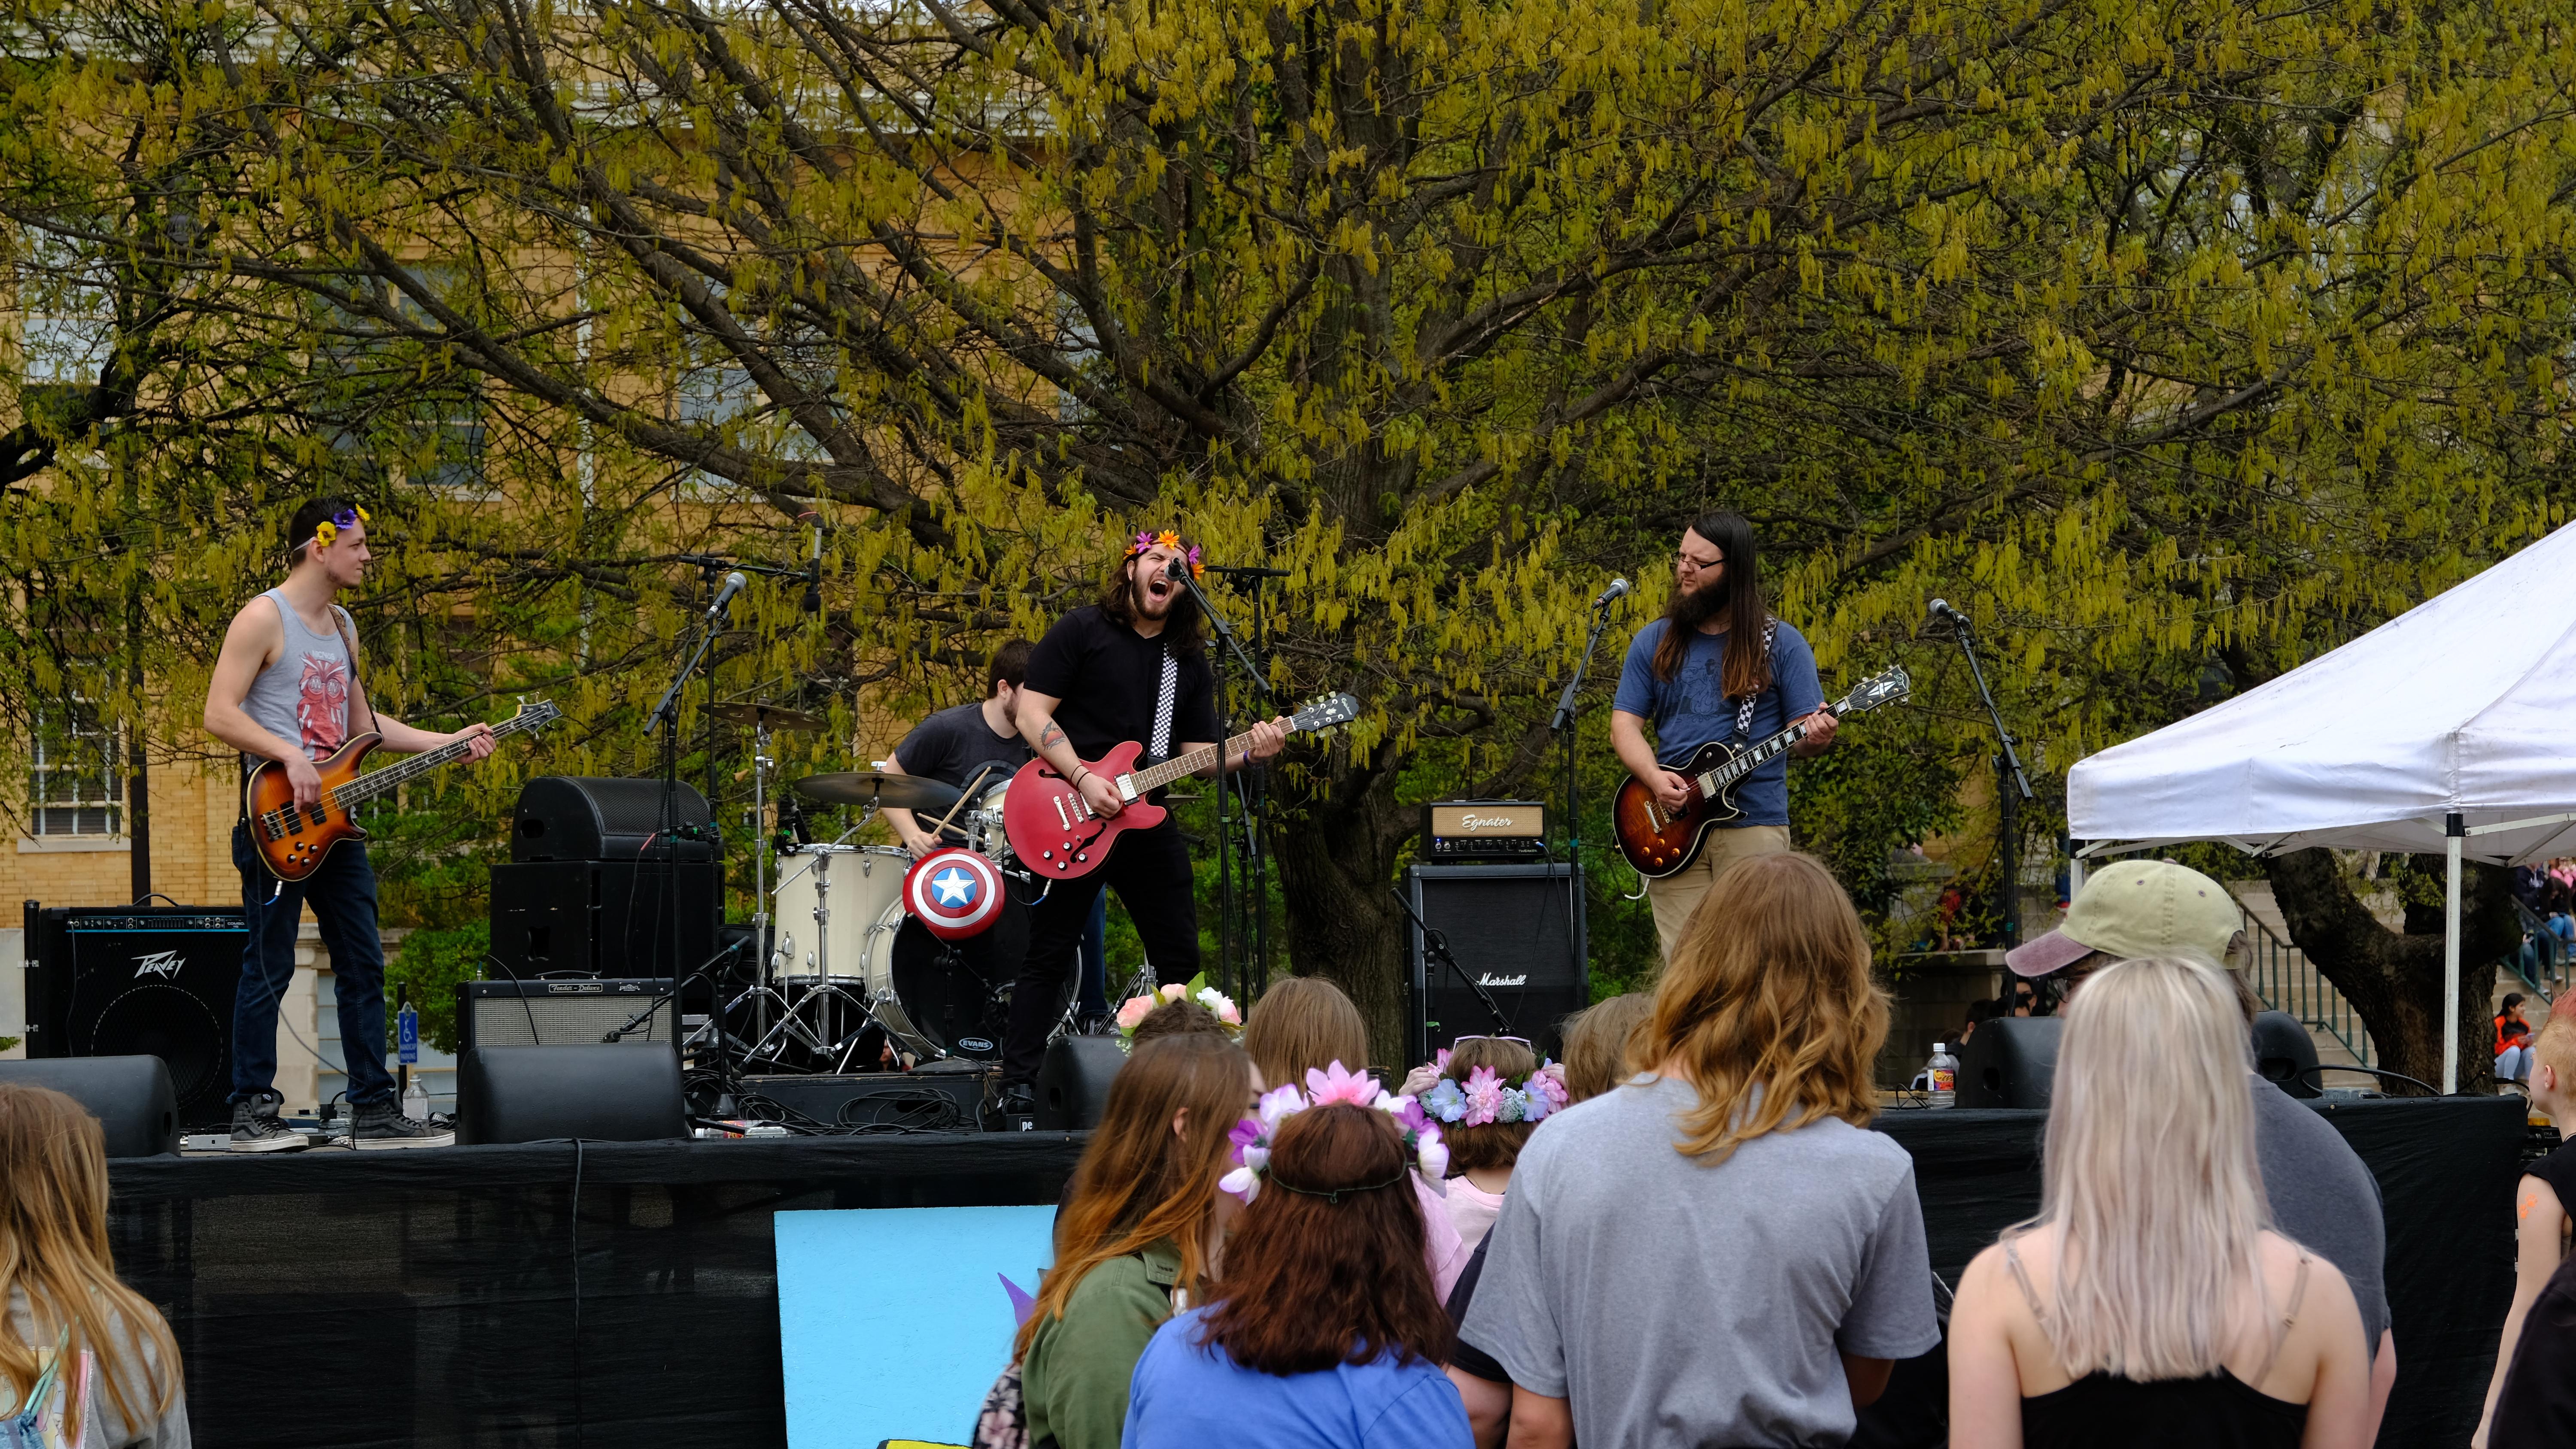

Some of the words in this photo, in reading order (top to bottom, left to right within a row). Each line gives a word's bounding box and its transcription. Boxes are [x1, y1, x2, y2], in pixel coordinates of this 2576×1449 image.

[1462, 814, 1513, 831] Egnater
[131, 950, 186, 979] PEAVEY
[1479, 972, 1527, 986] Marshall
[963, 1040, 989, 1048] EVANS
